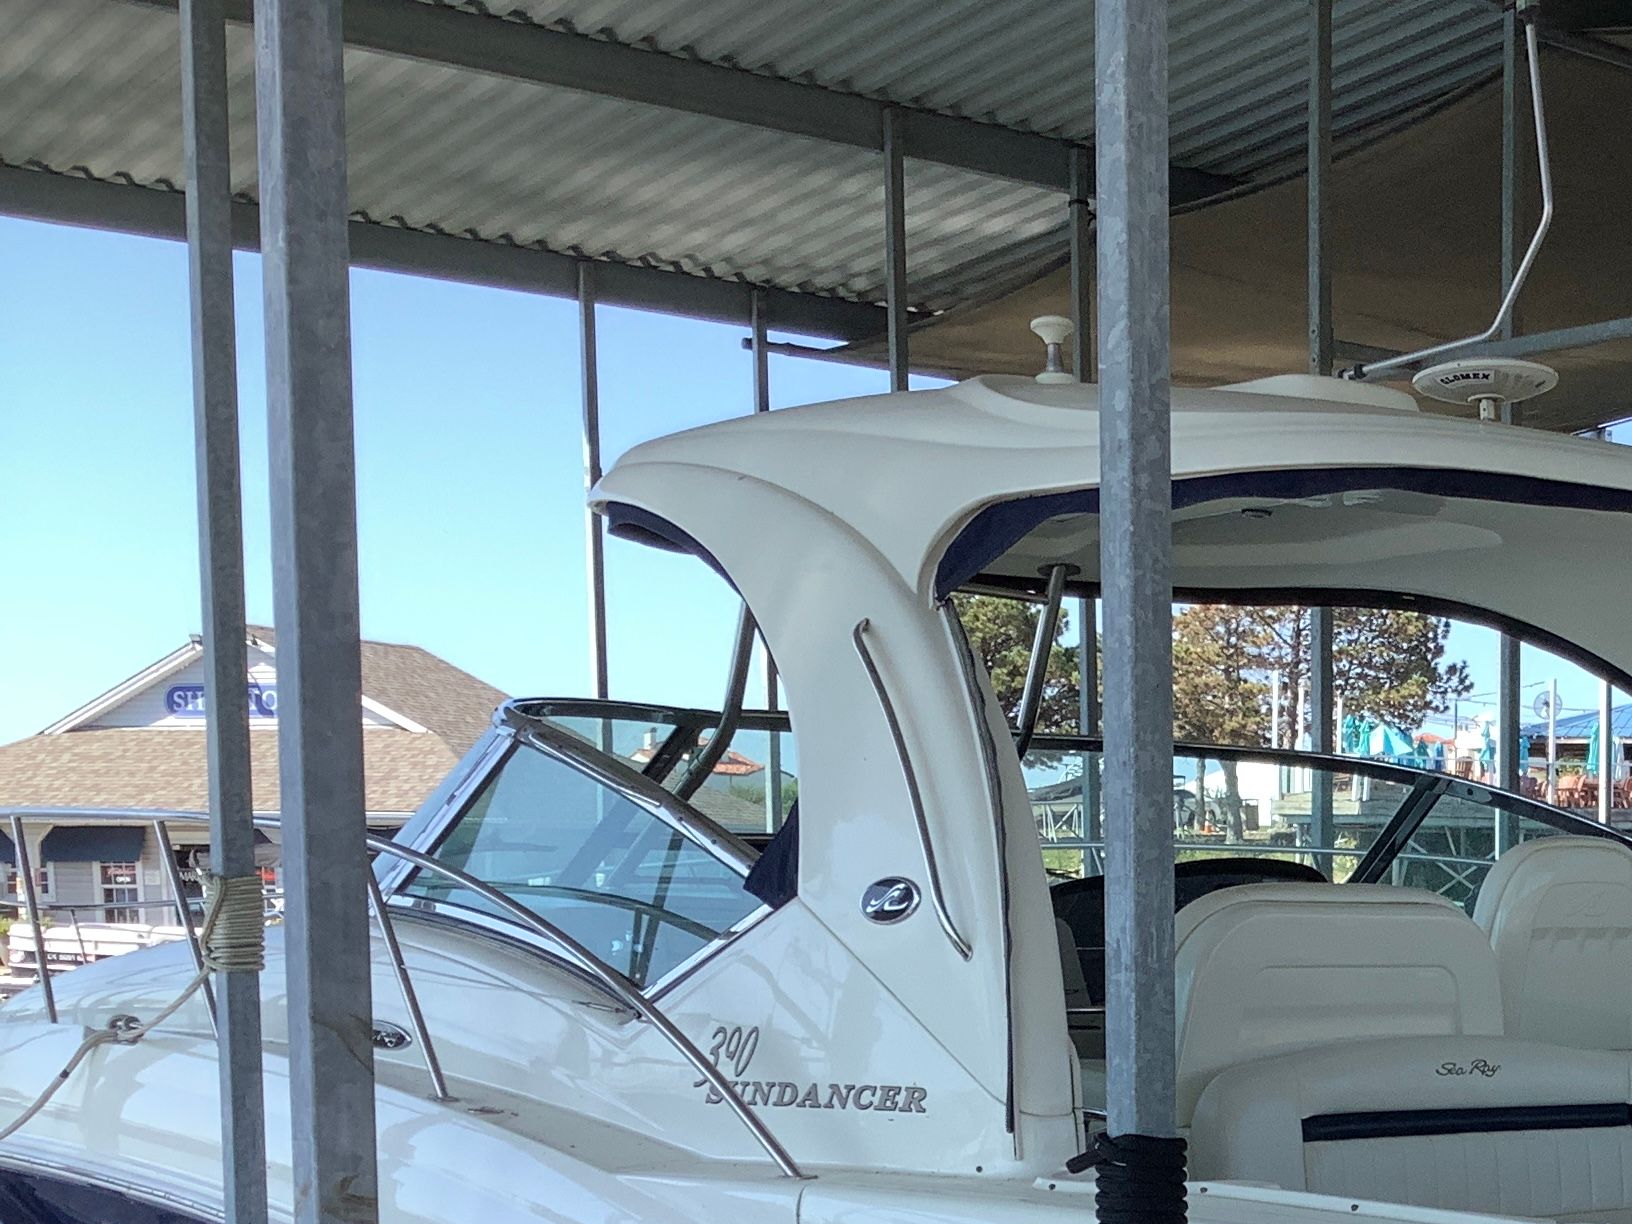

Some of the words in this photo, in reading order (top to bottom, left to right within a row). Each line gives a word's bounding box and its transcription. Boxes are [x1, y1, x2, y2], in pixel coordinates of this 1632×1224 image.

[1440, 372, 1490, 385] GLOMEX
[693, 1026, 759, 1087] 390
[1435, 1062, 1467, 1077] Sea
[1468, 1059, 1501, 1077] Ray
[705, 1081, 927, 1113] SUNDANCER
